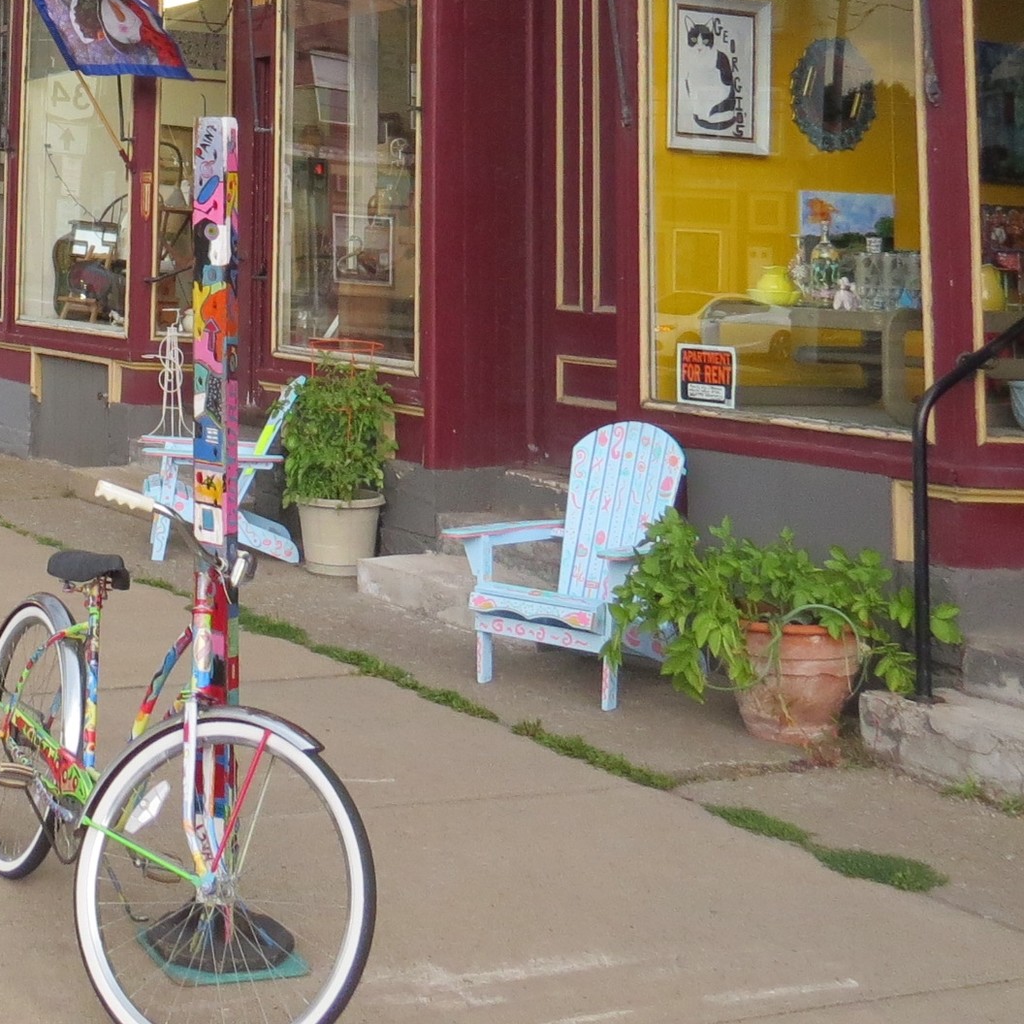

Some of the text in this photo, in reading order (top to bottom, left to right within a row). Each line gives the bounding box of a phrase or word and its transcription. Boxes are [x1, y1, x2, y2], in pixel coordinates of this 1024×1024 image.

[682, 350, 732, 366] APARTMENT
[681, 363, 732, 385] FOR RENT
